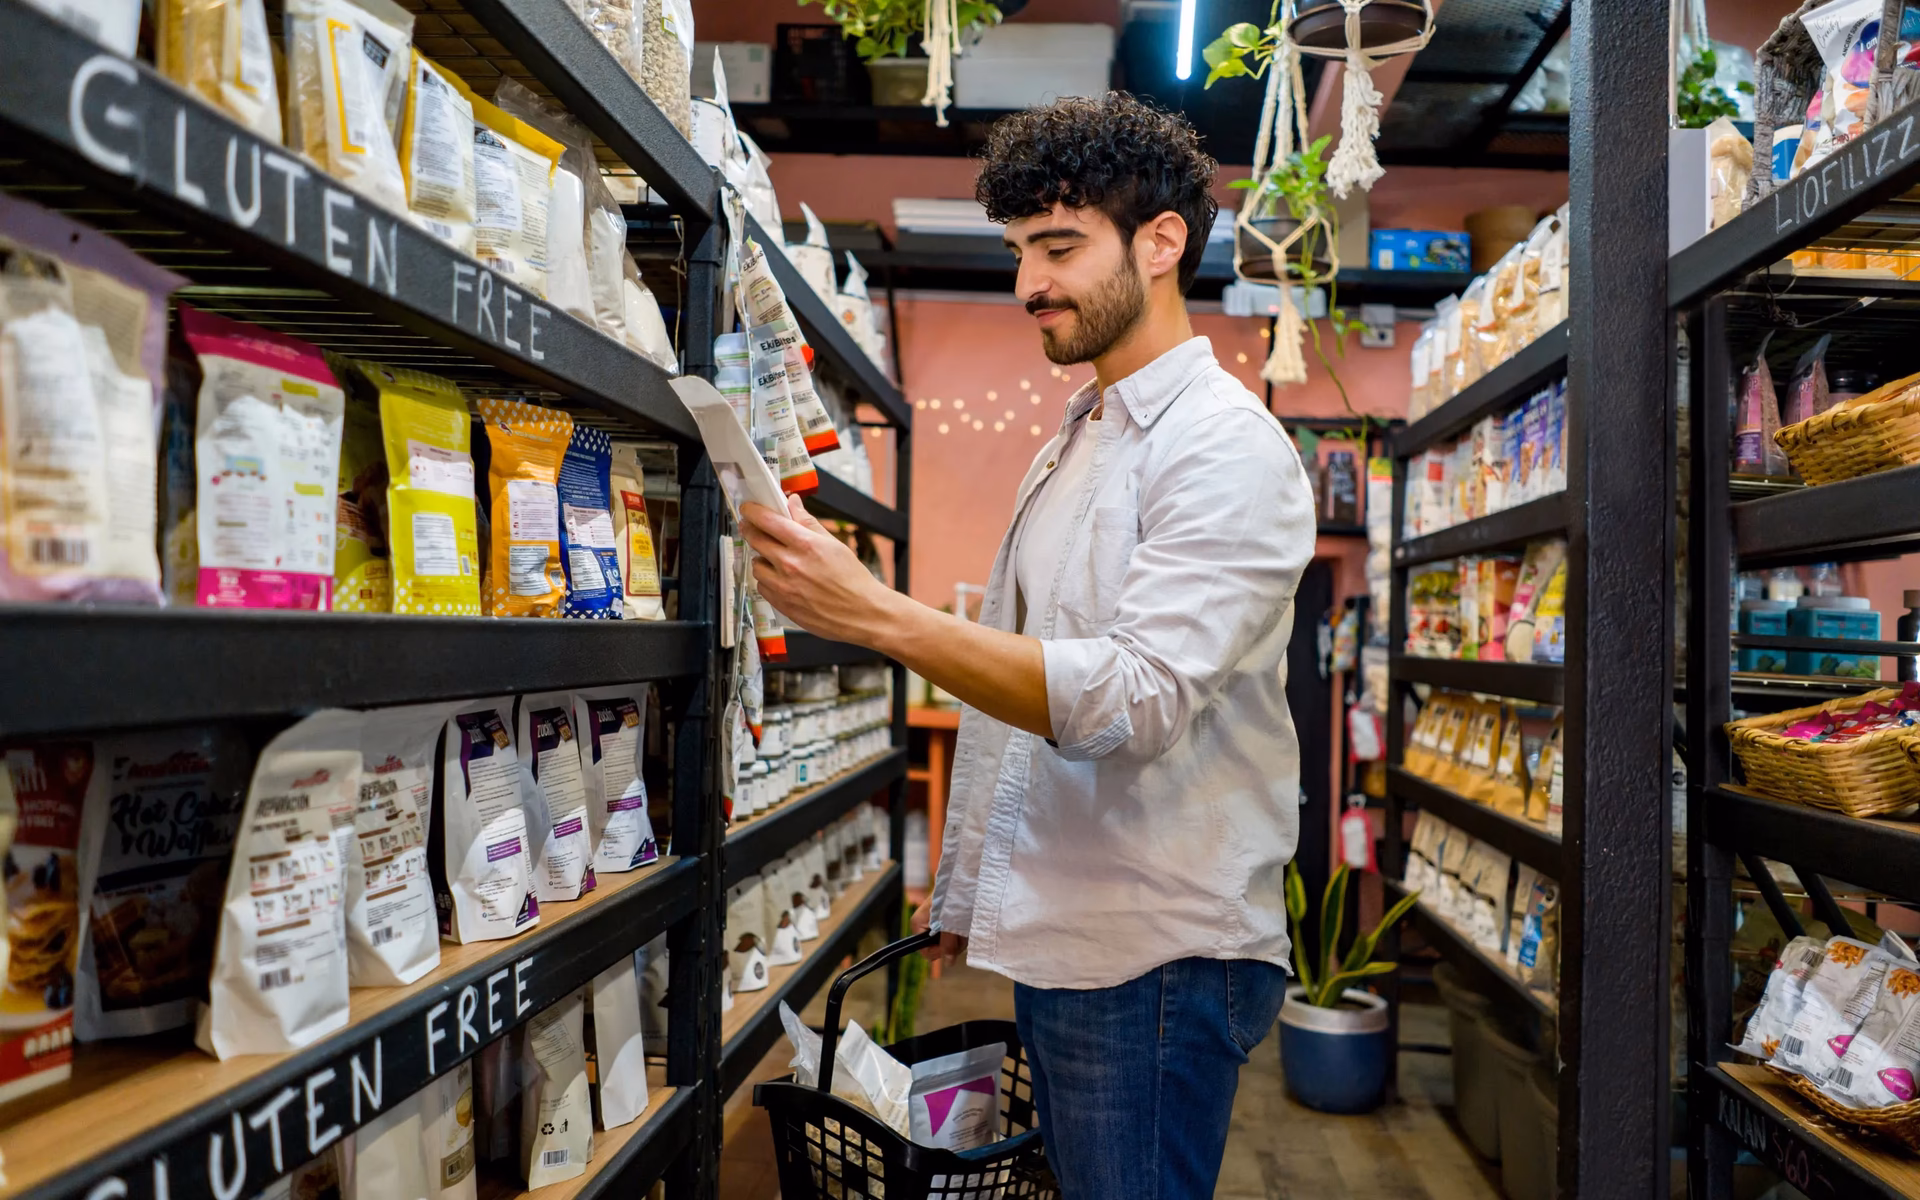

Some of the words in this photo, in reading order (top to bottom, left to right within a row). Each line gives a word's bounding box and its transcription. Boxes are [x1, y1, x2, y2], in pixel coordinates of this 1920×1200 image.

[69, 55, 400, 297] GLUTEN
[451, 261, 552, 361] FREE
[760, 335, 797, 351] EkiBites
[758, 370, 786, 387] EkiBites
[426, 955, 535, 1075] FREE
